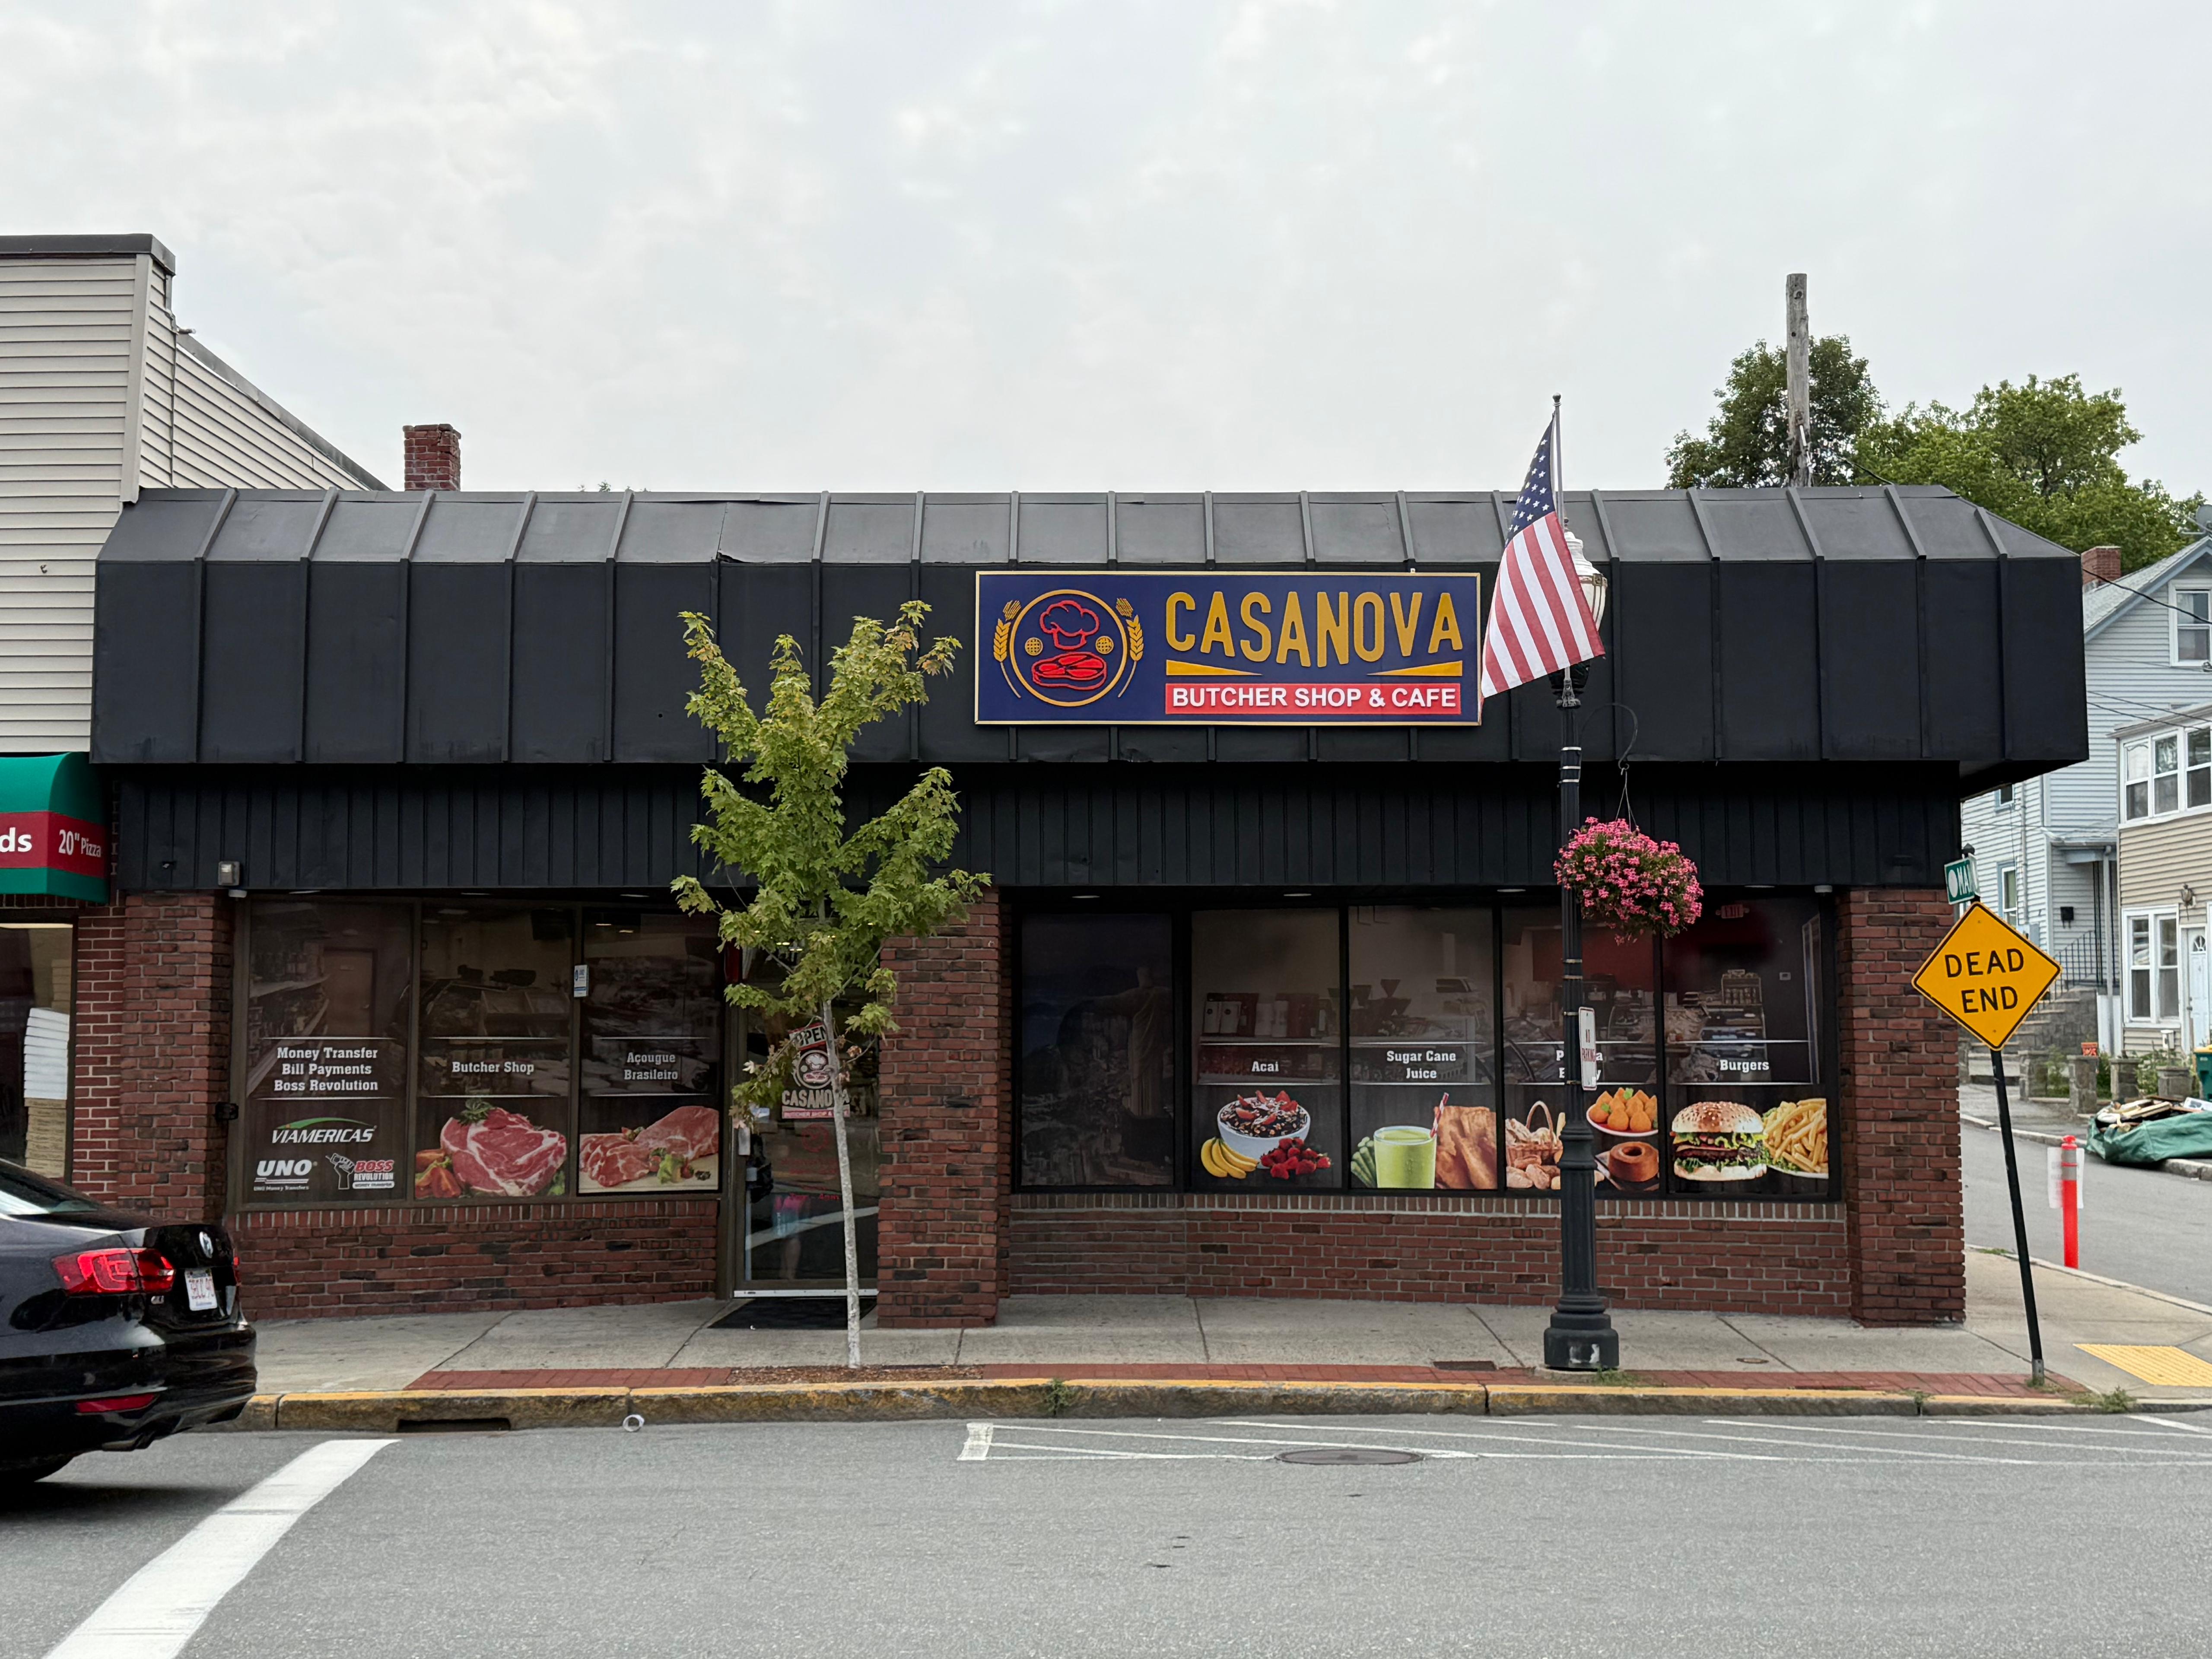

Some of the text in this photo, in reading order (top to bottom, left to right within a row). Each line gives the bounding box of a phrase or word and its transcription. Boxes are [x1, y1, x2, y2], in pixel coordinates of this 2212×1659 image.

[1166, 591, 1462, 667] CASANOVA
[1173, 687, 1457, 708] BUTCHER SHOP & CAFE
[58, 829, 102, 858] 20" Pizza
[1945, 948, 2024, 978] DEAD
[1961, 986, 2018, 1014] END
[277, 1047, 378, 1061] Money Transfer
[626, 1052, 676, 1065] Açougue
[1386, 1050, 1456, 1064] Sugar Cane
[282, 1063, 372, 1077] Bill Payments
[452, 1061, 534, 1075] Butcher Shop
[1252, 1061, 1279, 1072] Acai
[1406, 1067, 1437, 1079] Juice
[1719, 1059, 1770, 1073] Burgers
[624, 1069, 678, 1080] Brasileiro
[274, 1079, 378, 1091] Boss Revolution
[782, 1089, 850, 1109] CASANOA
[272, 1128, 374, 1143] VIAMERICAS
[257, 1159, 313, 1176] UNO
[354, 1160, 394, 1173] BOSS
[354, 1173, 394, 1181] REVOLUTION
